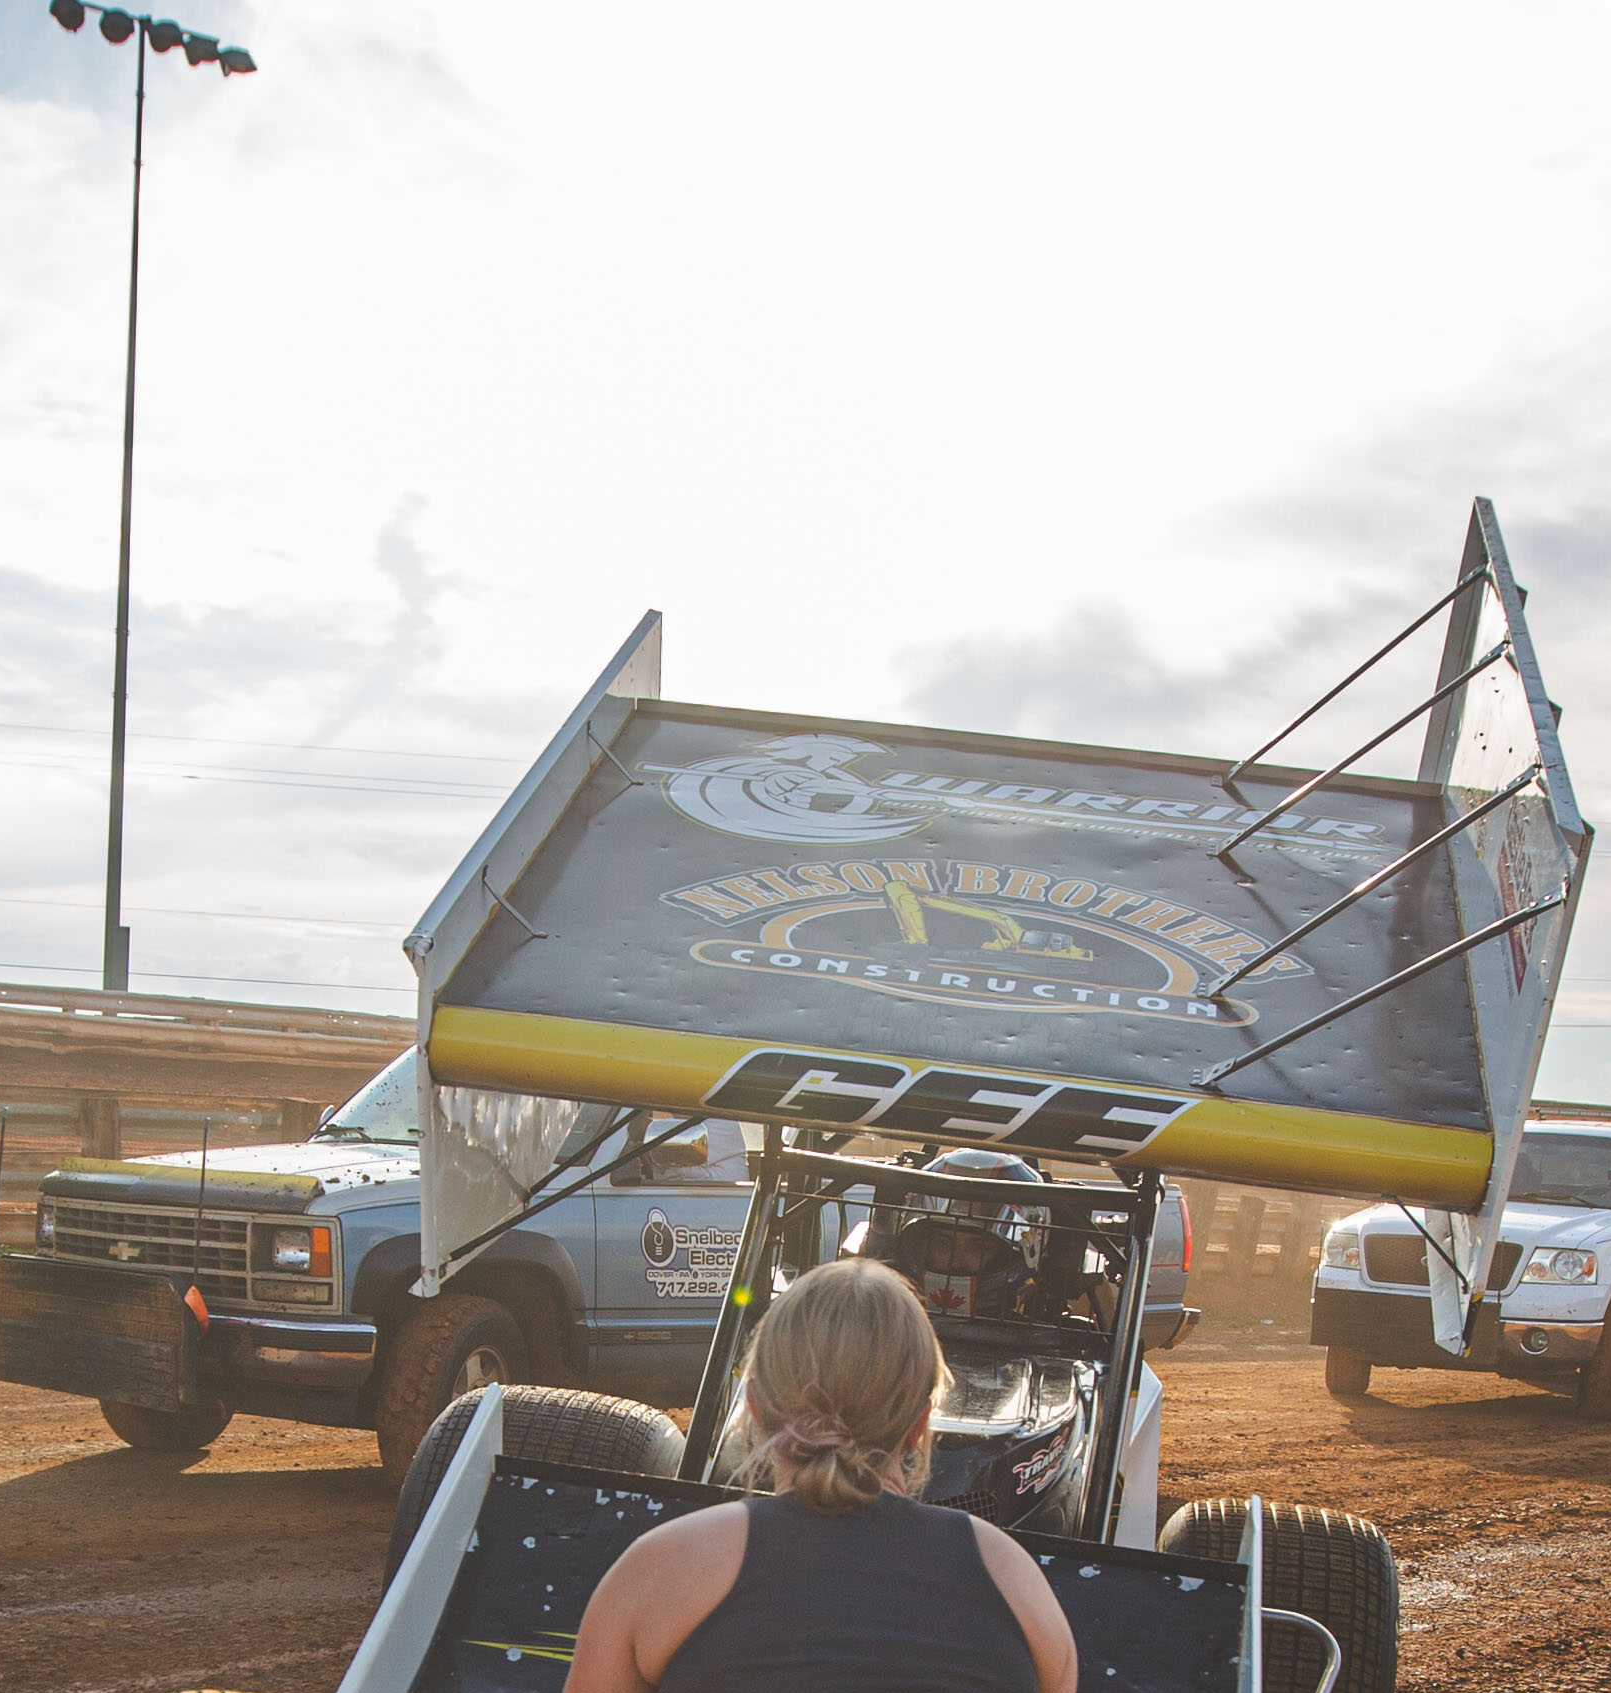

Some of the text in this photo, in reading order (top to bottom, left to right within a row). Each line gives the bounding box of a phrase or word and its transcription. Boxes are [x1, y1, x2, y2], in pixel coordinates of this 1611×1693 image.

[879, 772, 1378, 841] WARRIOR
[676, 860, 1302, 975] NELSON BROTHERS
[730, 949, 1217, 1018] CONSTRUCTION
